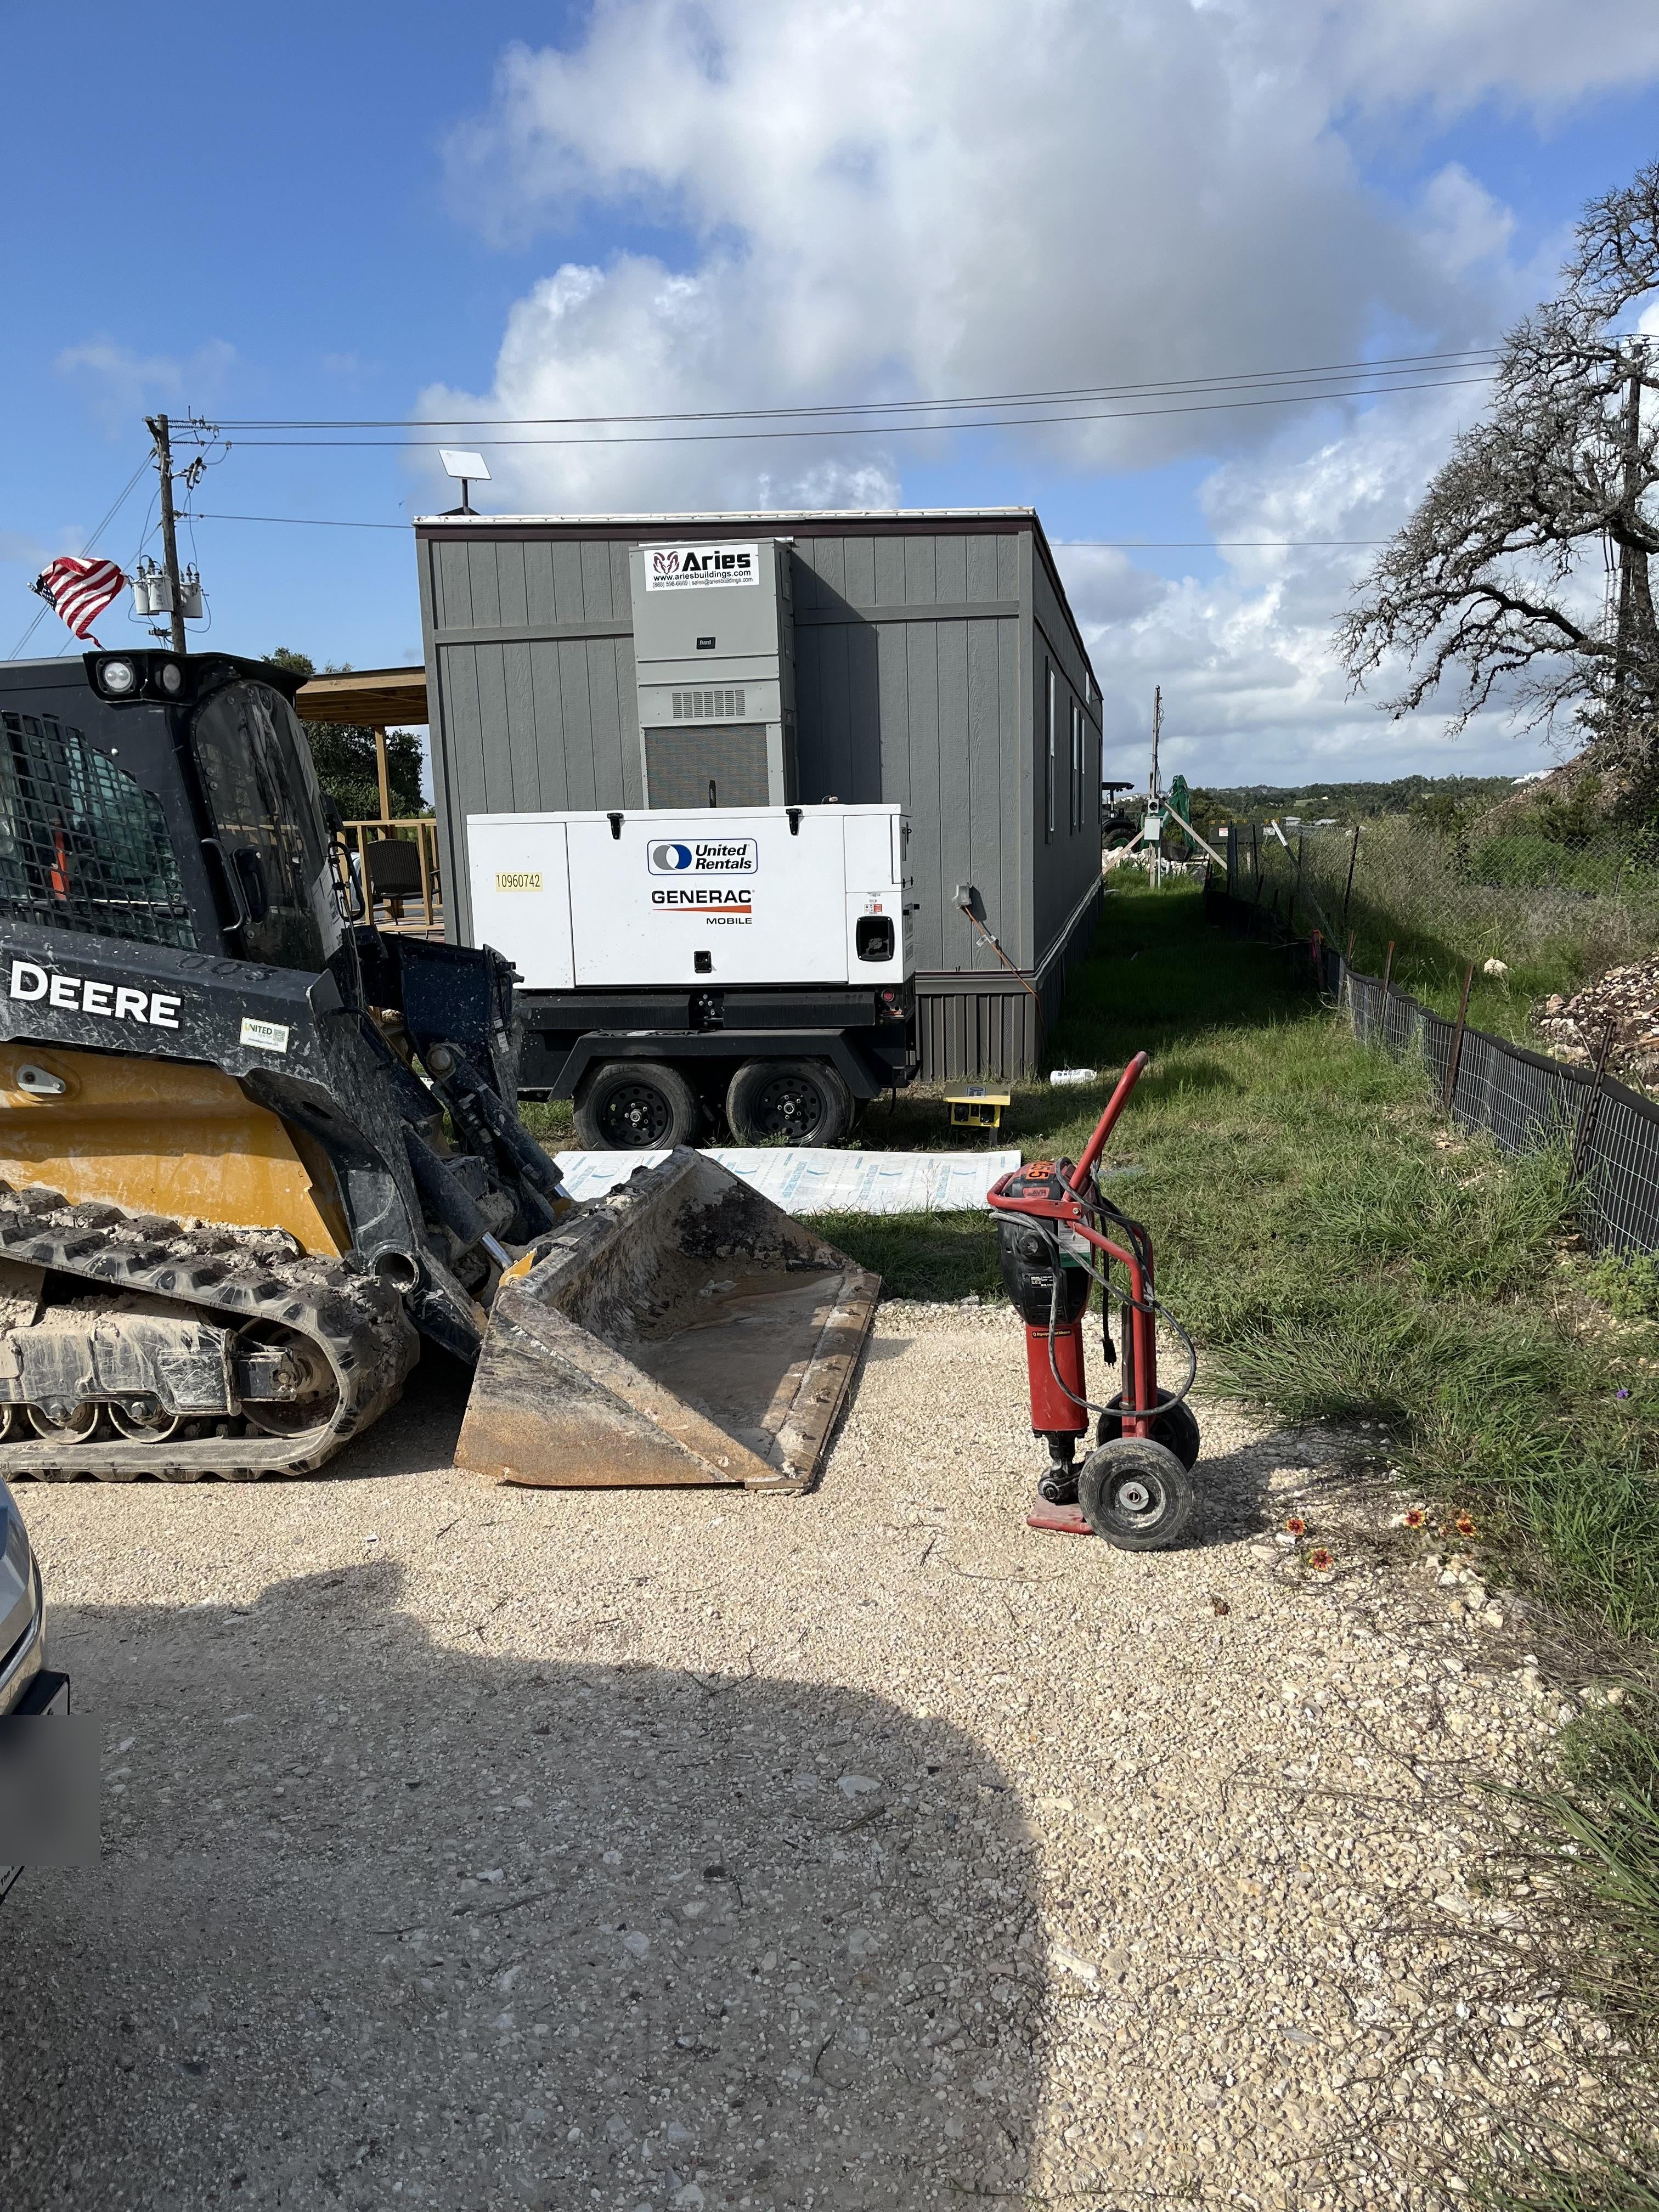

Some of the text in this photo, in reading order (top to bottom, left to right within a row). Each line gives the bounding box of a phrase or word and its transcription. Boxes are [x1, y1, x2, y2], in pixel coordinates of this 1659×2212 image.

[682, 550, 751, 572] Aries
[653, 571, 751, 581] www.ariesbuildings.com
[696, 844, 747, 856] United
[695, 857, 752, 870] Rentals
[496, 874, 540, 888] 10960742
[652, 890, 752, 904] GENERAC
[10, 960, 181, 1029] DEERE
